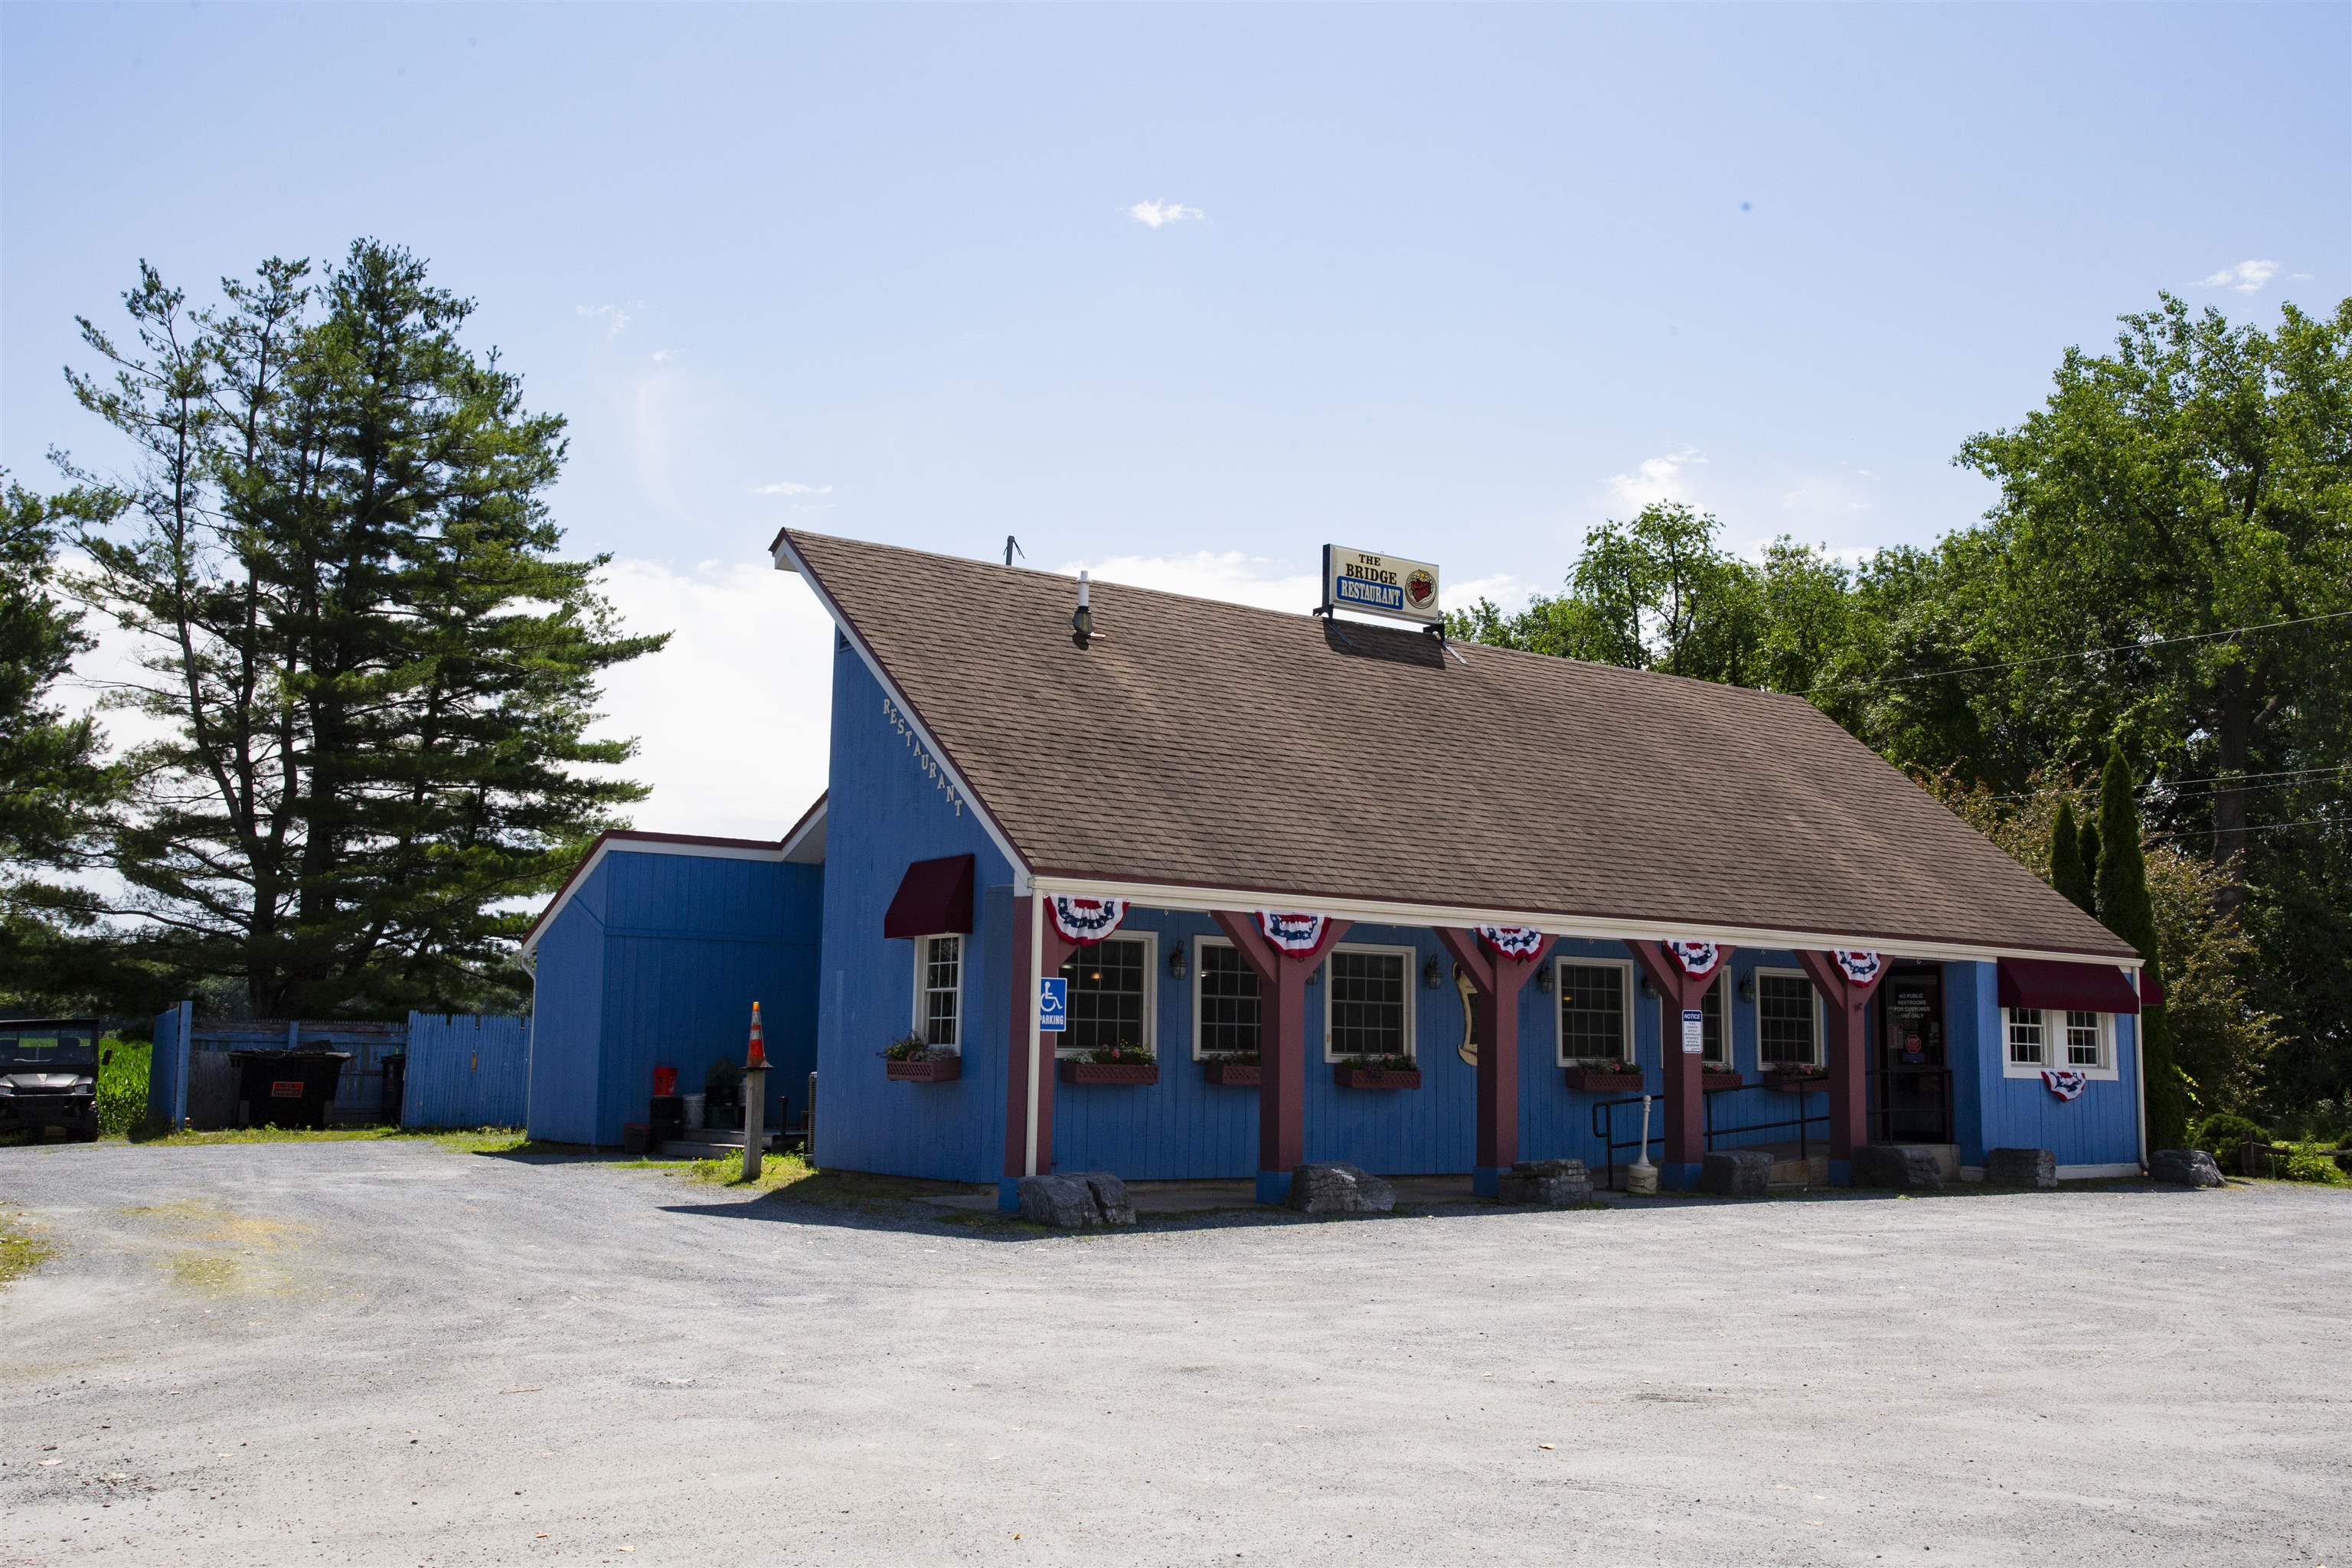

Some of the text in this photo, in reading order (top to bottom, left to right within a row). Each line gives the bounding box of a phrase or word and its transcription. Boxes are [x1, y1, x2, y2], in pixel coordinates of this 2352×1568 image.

[1359, 554, 1381, 567] THE
[1345, 563, 1397, 585] BRIDGE
[1341, 579, 1401, 607] RESTAURANT
[883, 698, 963, 817] RESTAURANT
